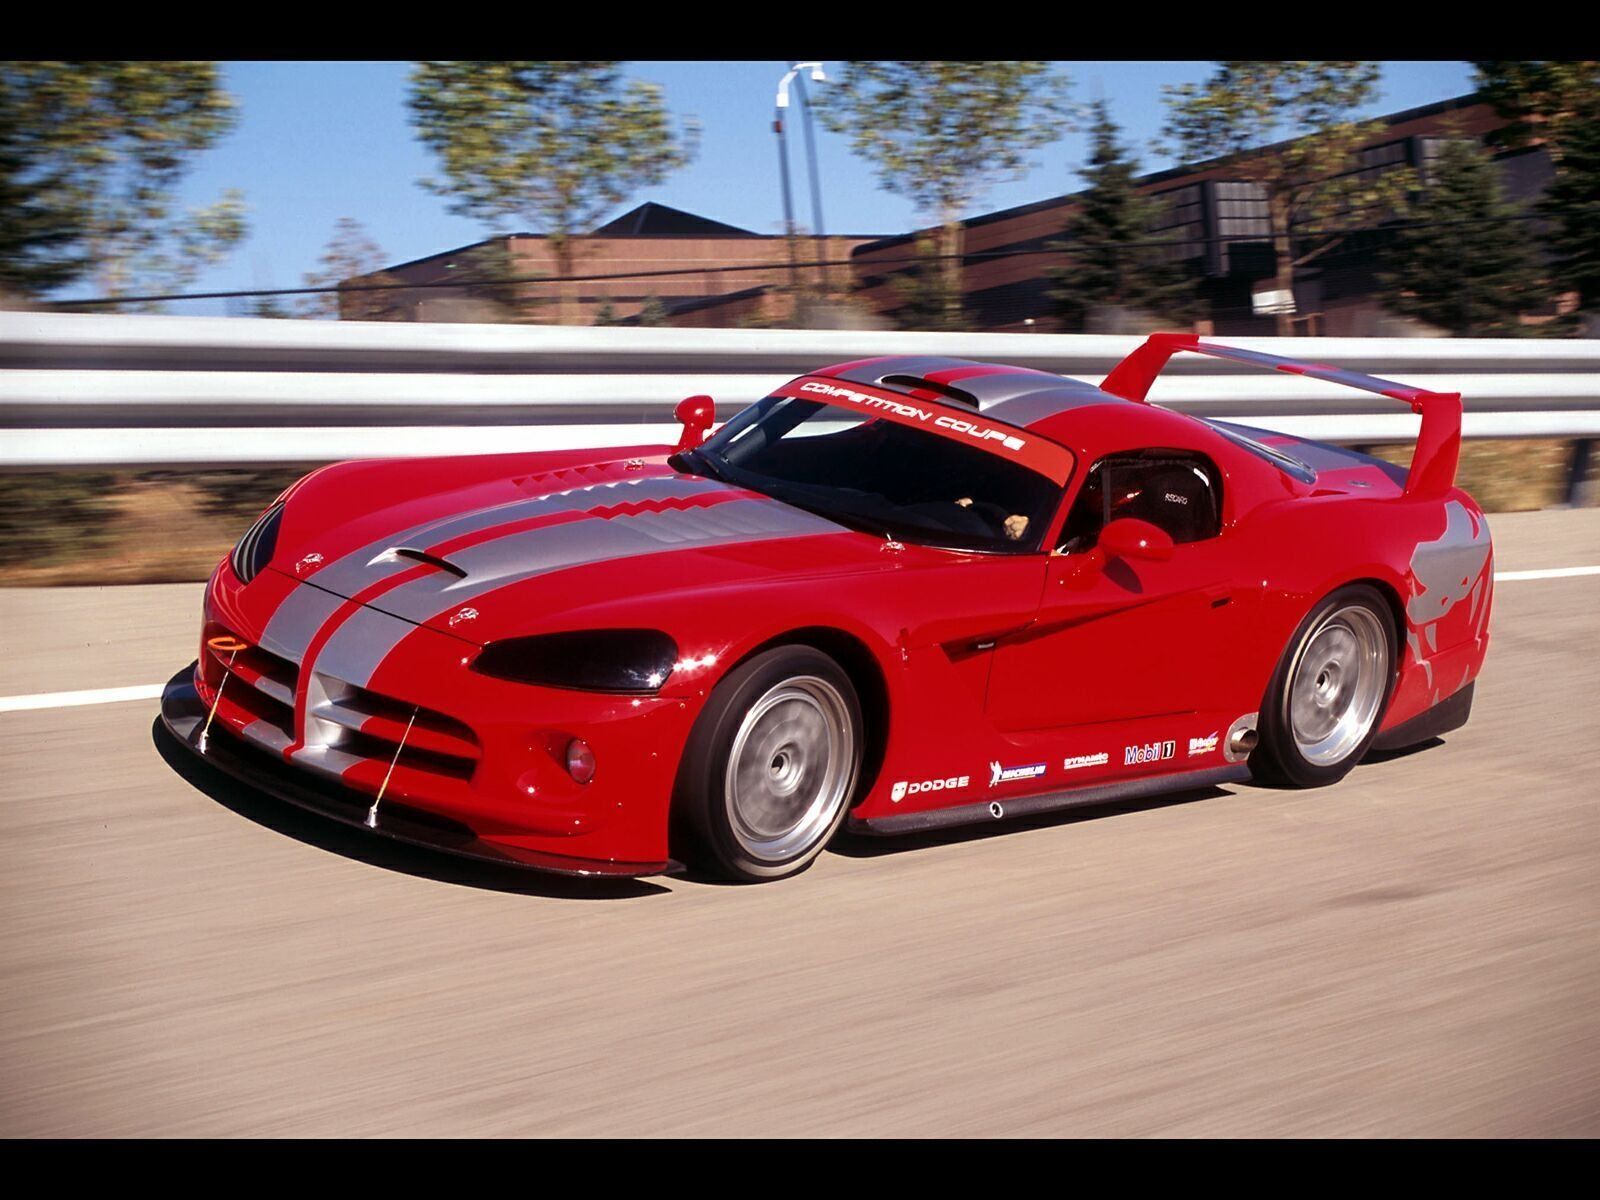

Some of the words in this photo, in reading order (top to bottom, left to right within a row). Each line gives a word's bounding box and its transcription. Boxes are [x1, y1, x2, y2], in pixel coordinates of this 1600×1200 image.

[800, 382, 932, 421] COMPETITION
[934, 416, 1026, 451] COUPE
[1124, 742, 1161, 765] Mobil
[1163, 742, 1174, 759] 1
[907, 776, 970, 795] DODGE
